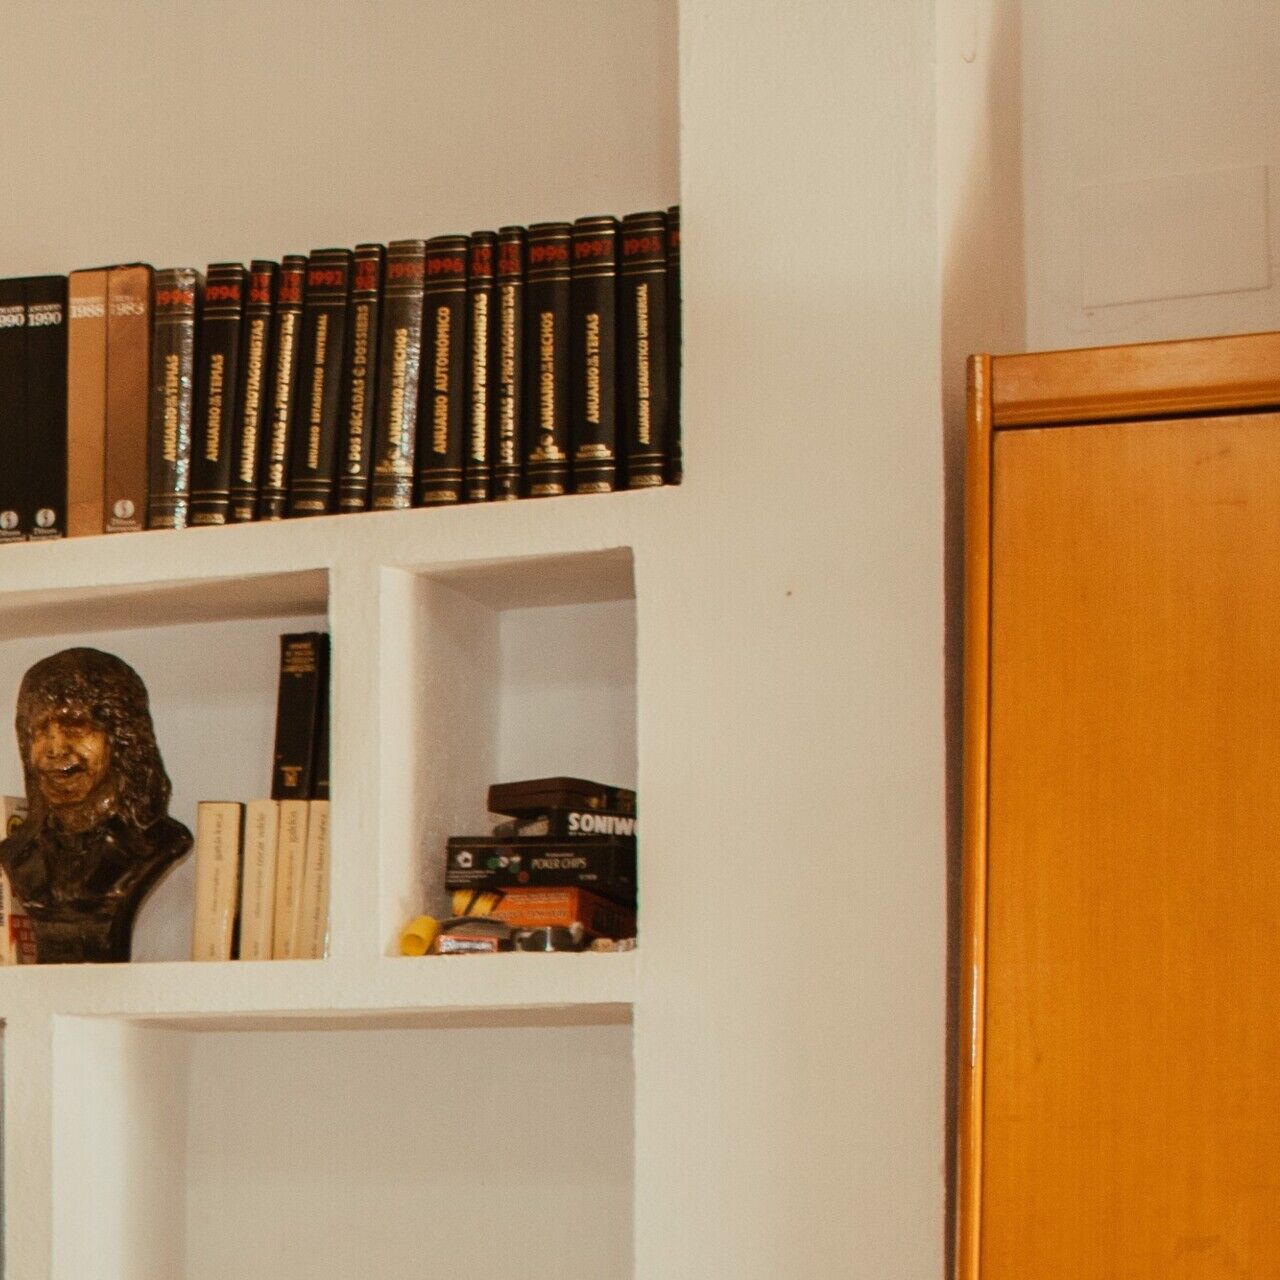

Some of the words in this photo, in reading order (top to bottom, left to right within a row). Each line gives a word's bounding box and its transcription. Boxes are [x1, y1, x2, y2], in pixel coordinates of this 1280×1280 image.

[28, 311, 62, 327] 1990
[542, 312, 554, 361] HECHOS
[542, 372, 554, 430] ANUARIO
[587, 367, 599, 423] ANUARIO
[207, 406, 222, 462] ANUARIO
[434, 396, 447, 454] ANUARIO
[568, 812, 638, 837] SONIW
[531, 857, 558, 870] POKER
[561, 857, 587, 869] CHIPS
